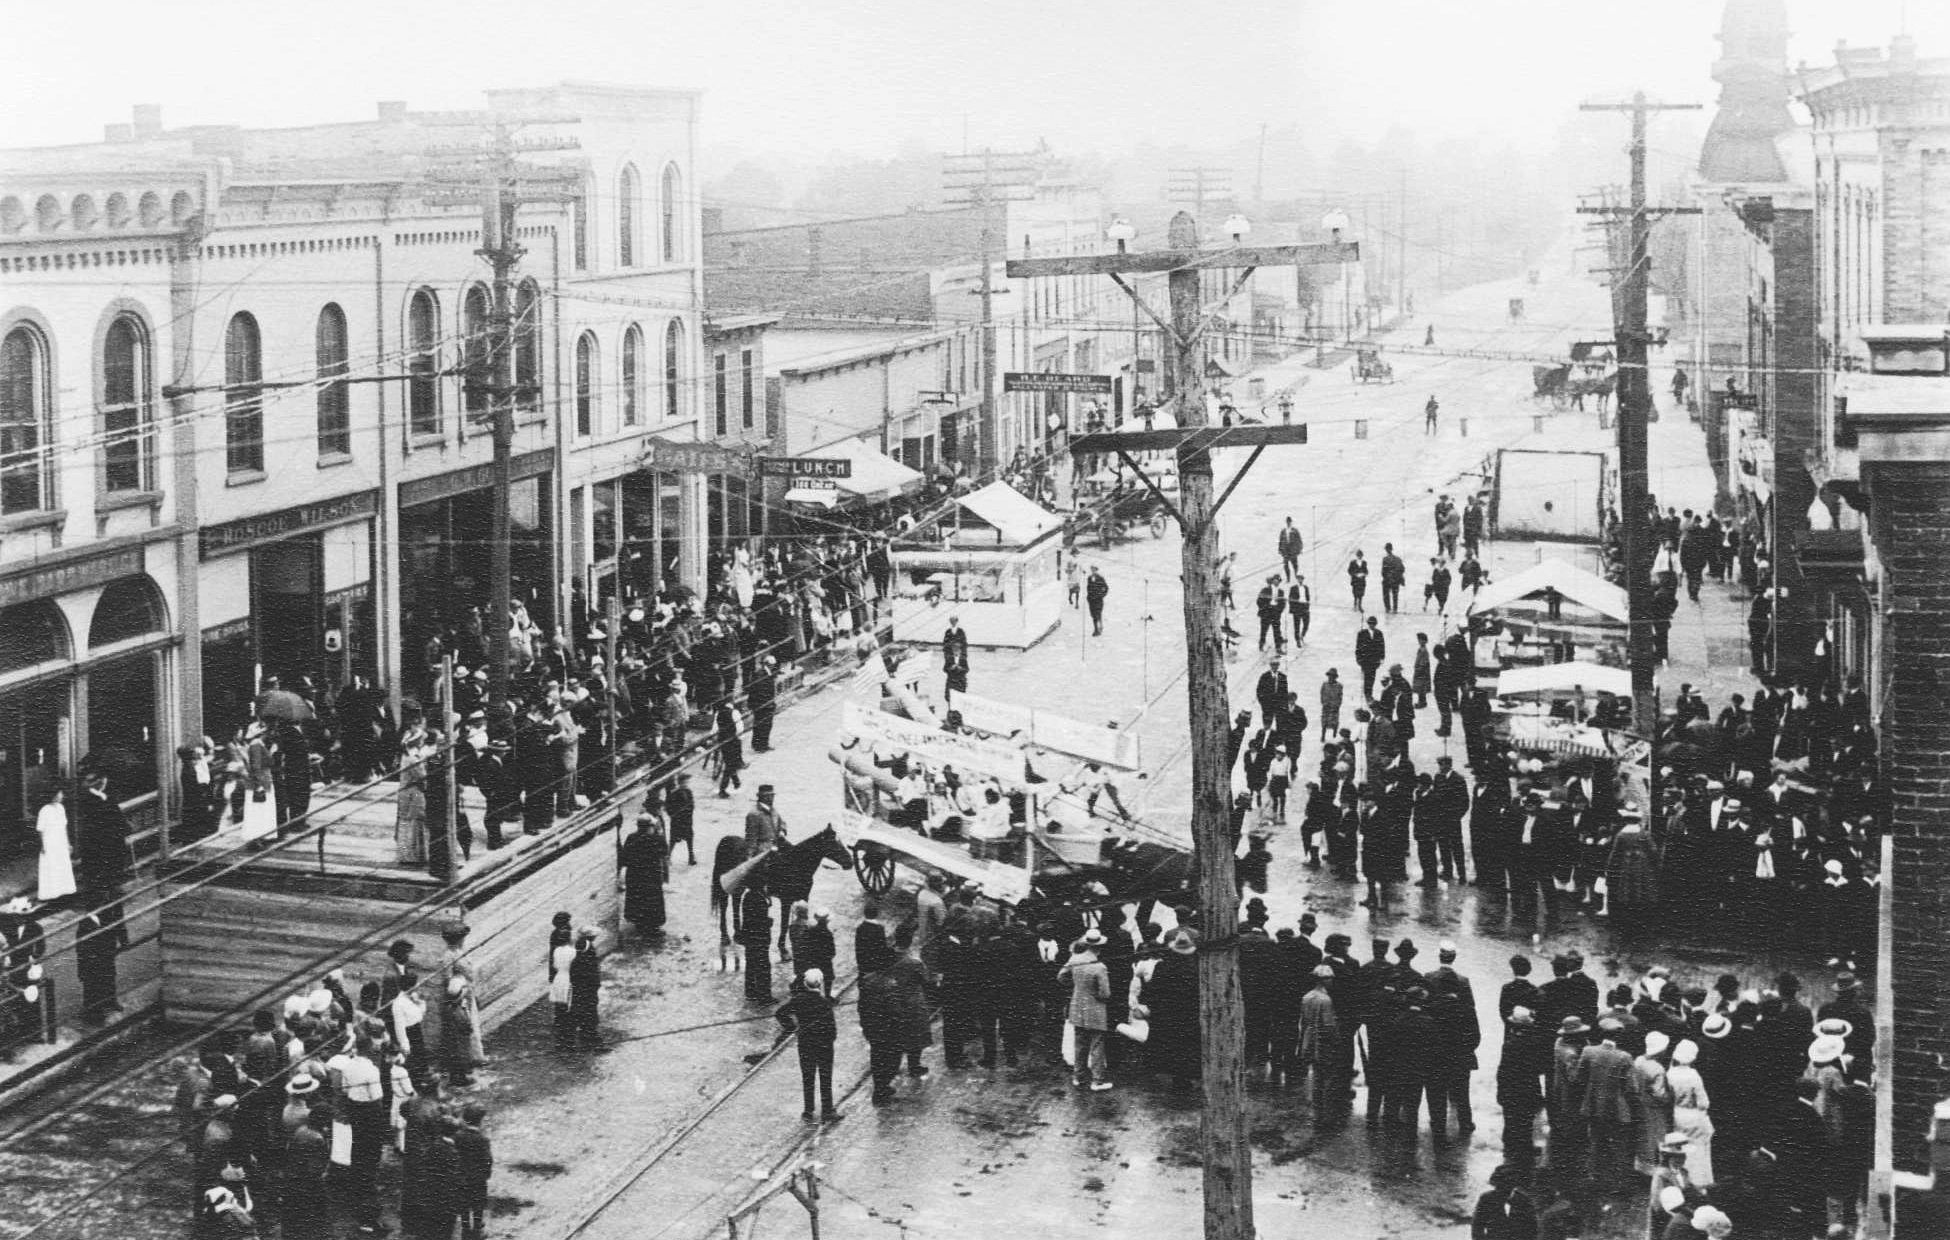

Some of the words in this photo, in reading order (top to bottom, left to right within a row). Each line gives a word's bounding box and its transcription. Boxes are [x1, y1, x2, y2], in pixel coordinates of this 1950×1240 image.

[792, 461, 845, 475] LUNCH
[223, 516, 288, 545] ROSCOE
[300, 495, 361, 525] WILSON
